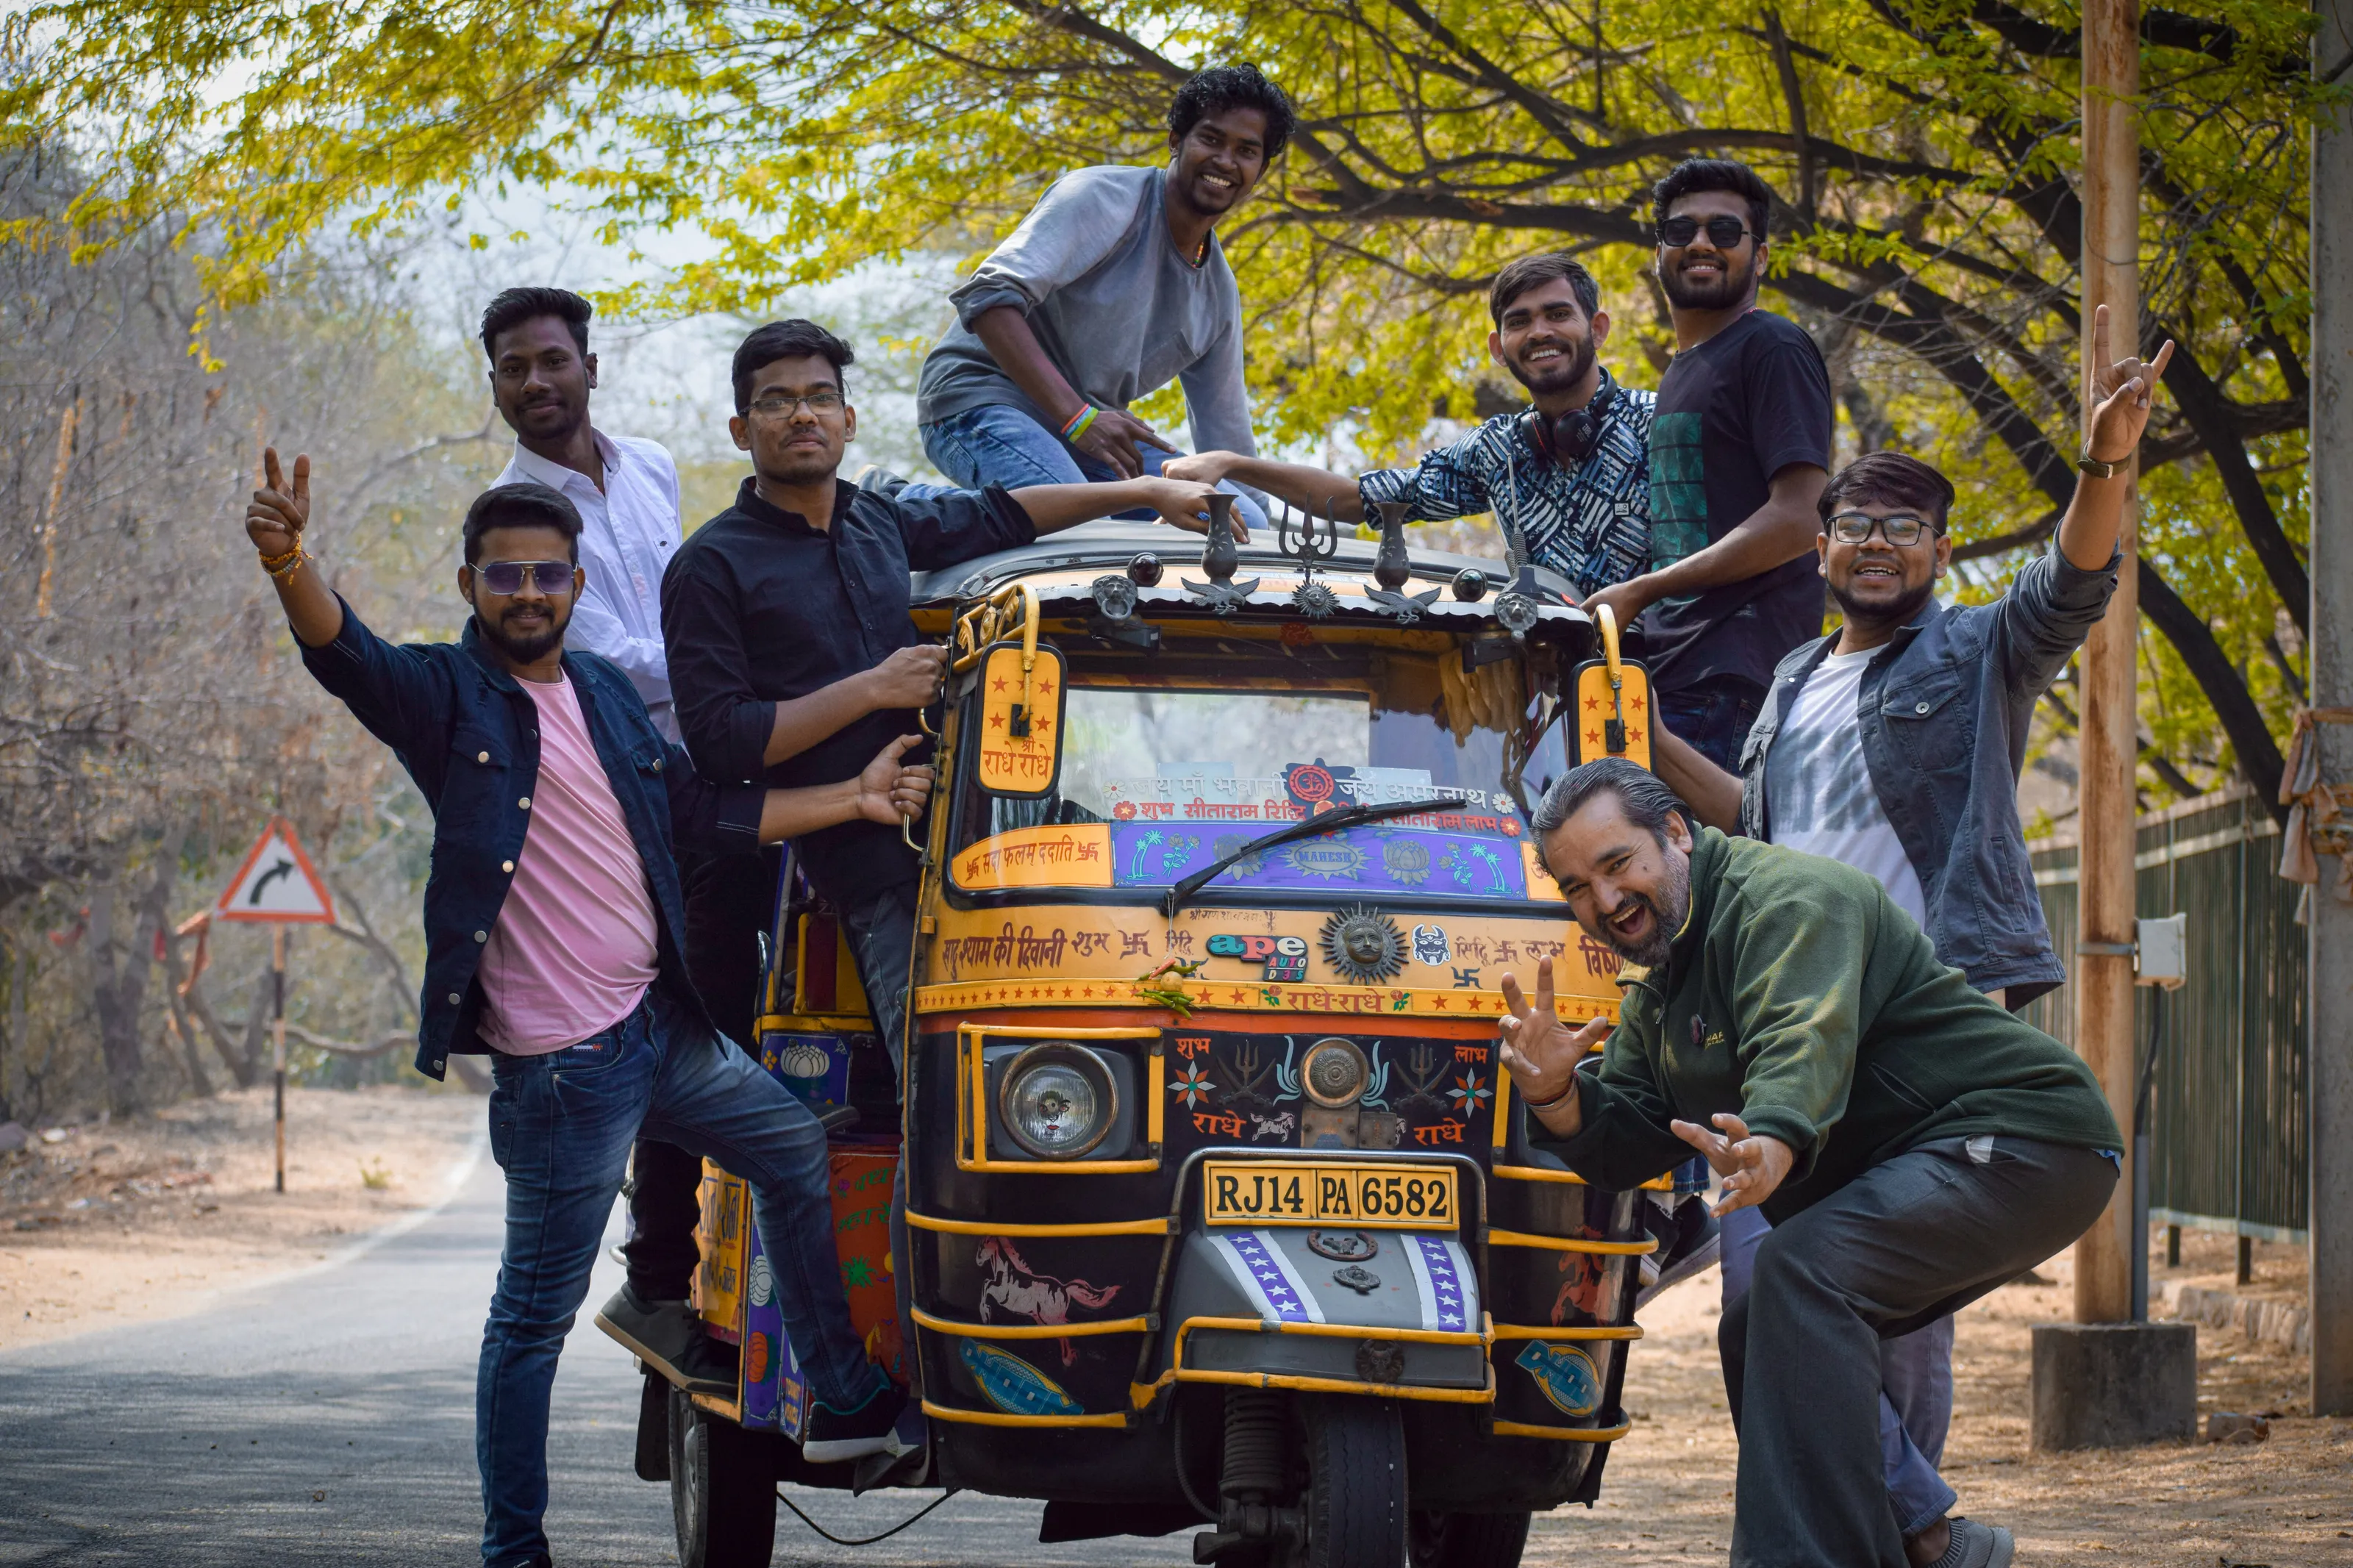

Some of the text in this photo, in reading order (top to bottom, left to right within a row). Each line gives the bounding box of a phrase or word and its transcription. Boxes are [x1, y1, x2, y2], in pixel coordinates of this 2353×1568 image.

[1582, 423, 1593, 438] JBL
[1021, 734, 1036, 753] श्री
[982, 740, 1051, 780] राधे राधे
[1130, 778, 1174, 796] जय
[1212, 771, 1287, 797] भवानी
[1335, 778, 1379, 802] जय
[1386, 782, 1487, 809] अमरनाथ
[1139, 801, 1175, 820] शुभ
[1183, 797, 1259, 820] सीताराम
[1463, 815, 1498, 832] लाभ
[982, 848, 1001, 873] सदा
[1038, 834, 1074, 864] ददाति
[1299, 851, 1352, 862] MAHESH
[994, 921, 1017, 968] की
[1071, 931, 1110, 957] शुभ
[1210, 935, 1306, 959] ape
[1268, 957, 1307, 968] AUTO
[1174, 1037, 1212, 1059] शुभ
[1454, 1045, 1488, 1064] लाभ
[1193, 1109, 1247, 1139] राधे
[1413, 1117, 1465, 1146] राधे
[1215, 1175, 1447, 1217] RJ14 PA 6582
